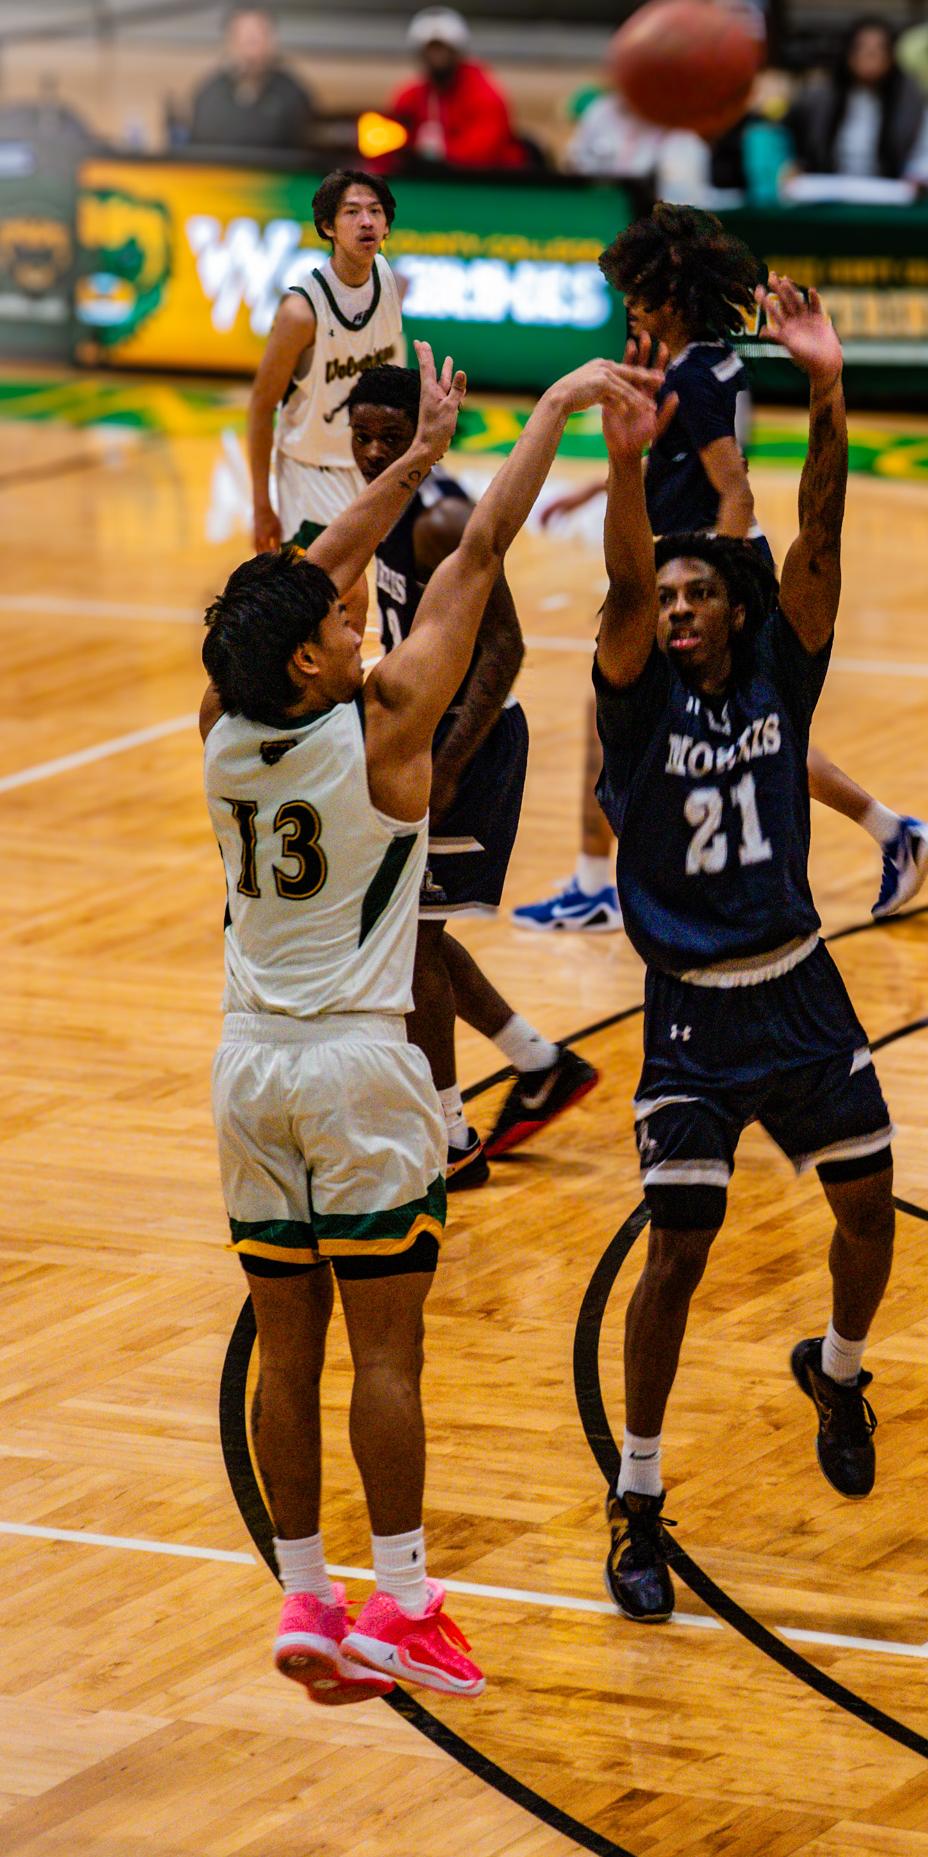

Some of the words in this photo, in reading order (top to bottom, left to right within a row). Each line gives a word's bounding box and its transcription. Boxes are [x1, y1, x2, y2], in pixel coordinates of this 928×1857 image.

[664, 712, 783, 779] MORRIS
[220, 796, 328, 901] 13
[683, 772, 773, 876] 21
